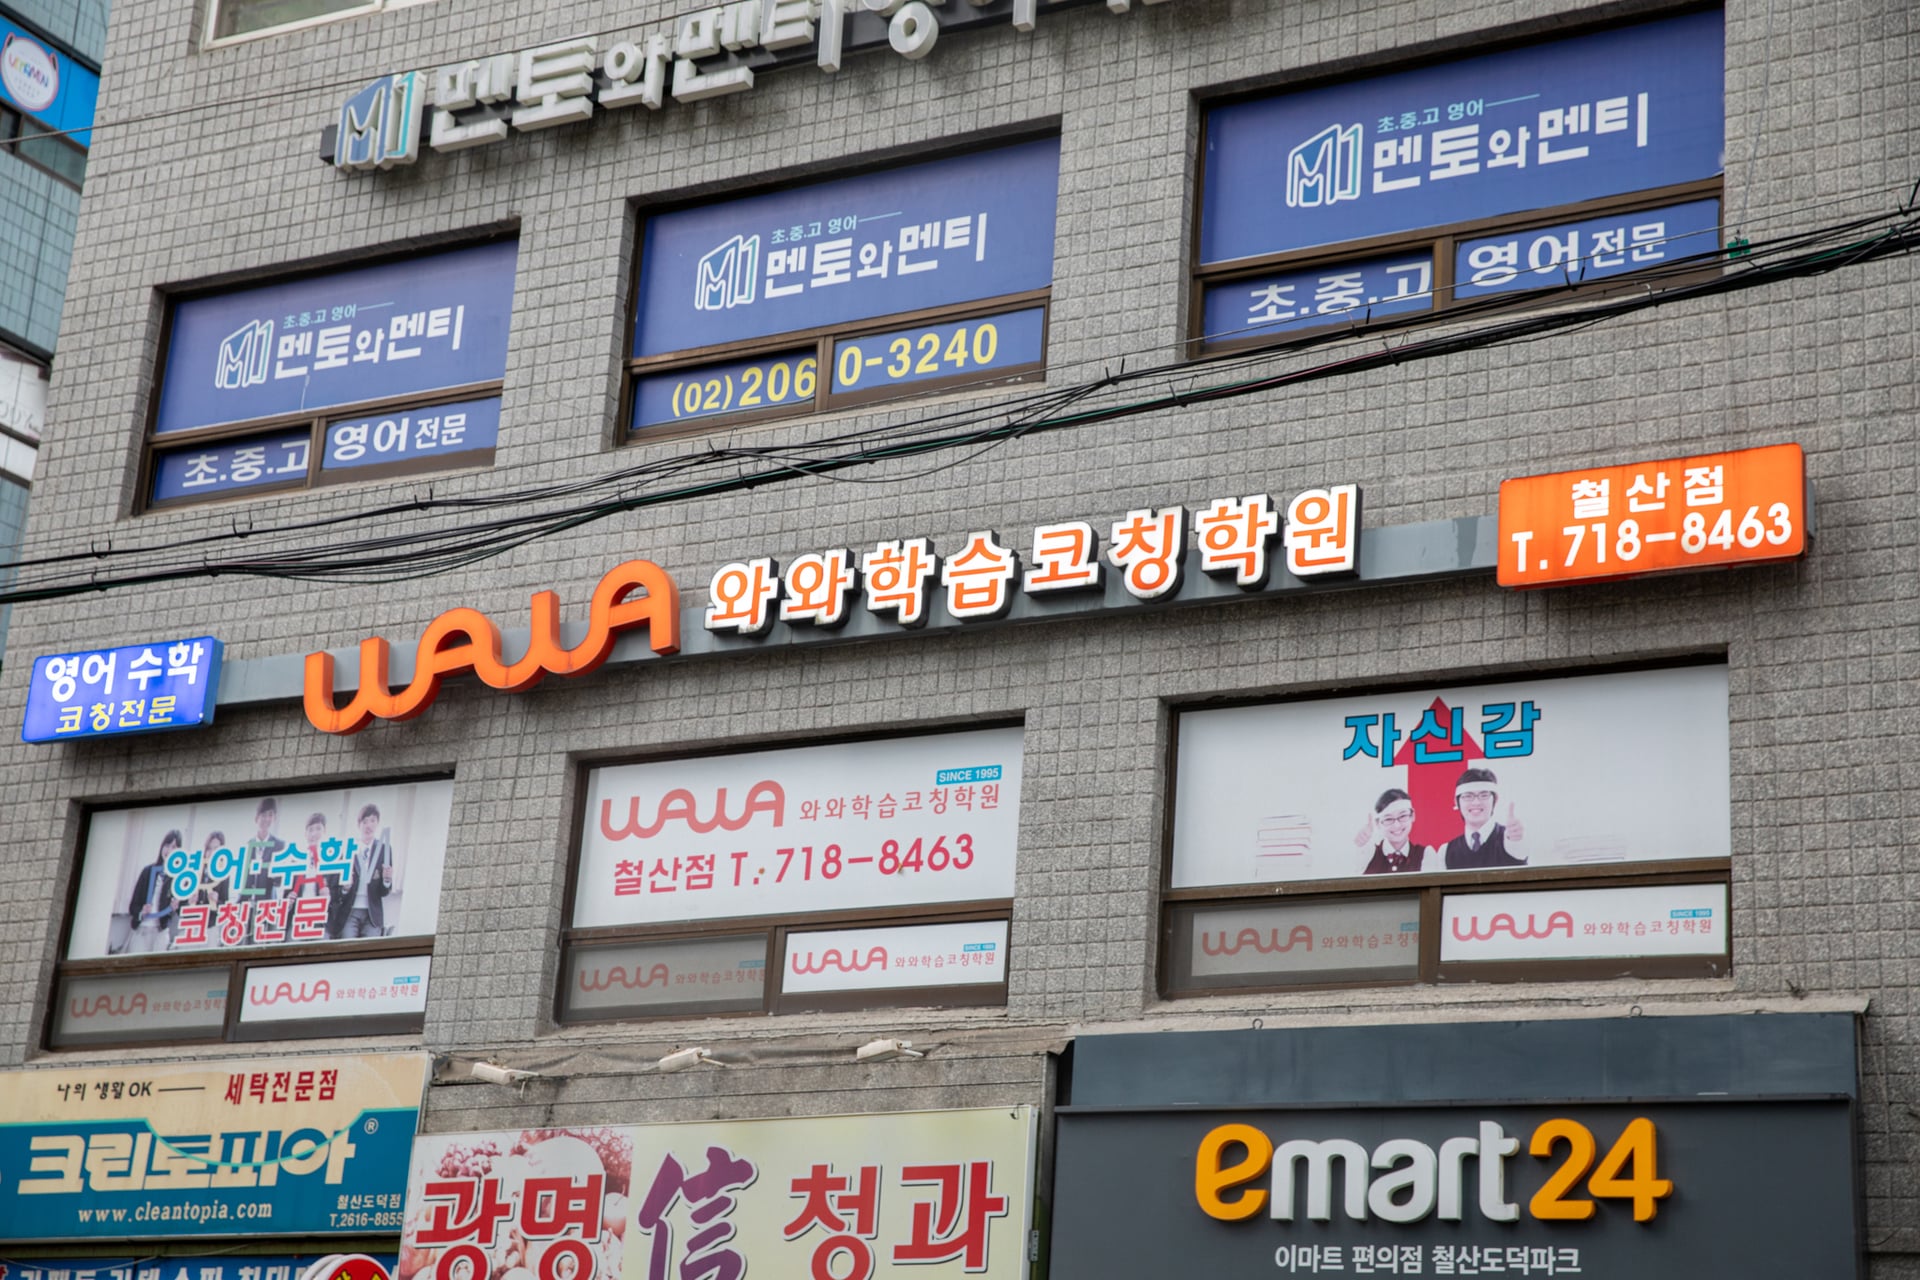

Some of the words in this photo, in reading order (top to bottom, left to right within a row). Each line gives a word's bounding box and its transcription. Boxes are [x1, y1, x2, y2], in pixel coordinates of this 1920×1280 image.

[1447, 98, 1483, 122] 영어
[1373, 92, 1648, 193] 멘토와멘티
[828, 214, 857, 234] 영어
[764, 213, 987, 299] 멘토와멘티
[1468, 231, 1580, 287] 영어
[1591, 222, 1667, 268] 전문
[332, 304, 357, 321] 영어
[274, 305, 464, 380] 멘토와멘티
[332, 418, 408, 461] 영어
[415, 413, 466, 448] 전문
[1572, 465, 1723, 519] 철산점
[45, 652, 117, 702] 영어
[128, 642, 204, 691] 수학
[55, 695, 176, 732] 코칭전문
[1342, 700, 1542, 767] 자신감
[939, 770, 972, 783] SINCE
[975, 767, 999, 780] 1995
[800, 783, 1000, 821] 와와학습코칭학원
[614, 853, 715, 896] 철산점
[174, 898, 328, 945] 코칭전문
[224, 1069, 339, 1105] 세탁전문점
[17, 1127, 356, 1194] 크린토피아
[78, 1200, 273, 1225] www.cleantopia.com
[415, 1173, 604, 1280] 광명
[784, 1160, 1006, 1280] 청과
[1275, 1245, 1344, 1272] 이마트
[1352, 1245, 1422, 1273] 편의점
[1432, 1246, 1582, 1275] 철산도덕파크
